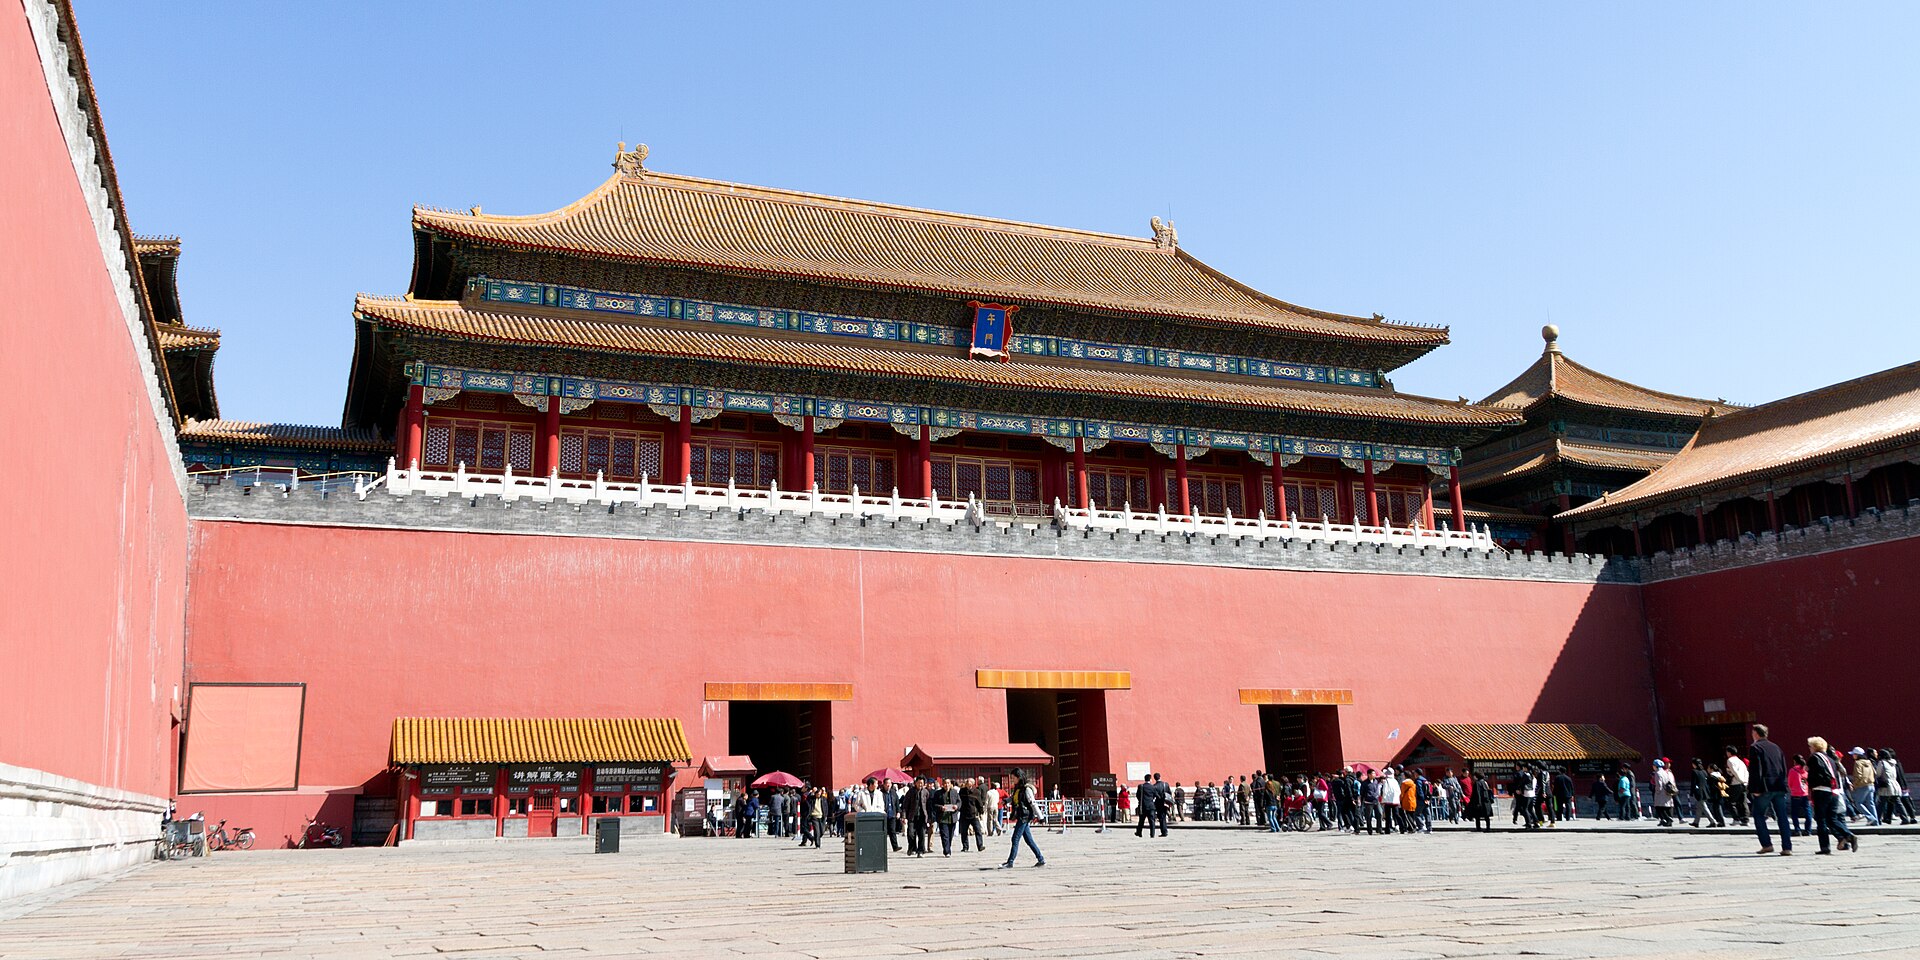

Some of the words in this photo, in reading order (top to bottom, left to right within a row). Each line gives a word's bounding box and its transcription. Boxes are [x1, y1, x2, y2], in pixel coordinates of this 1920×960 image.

[648, 766, 661, 774] Guide
[513, 771, 578, 779] 讲解服务处
